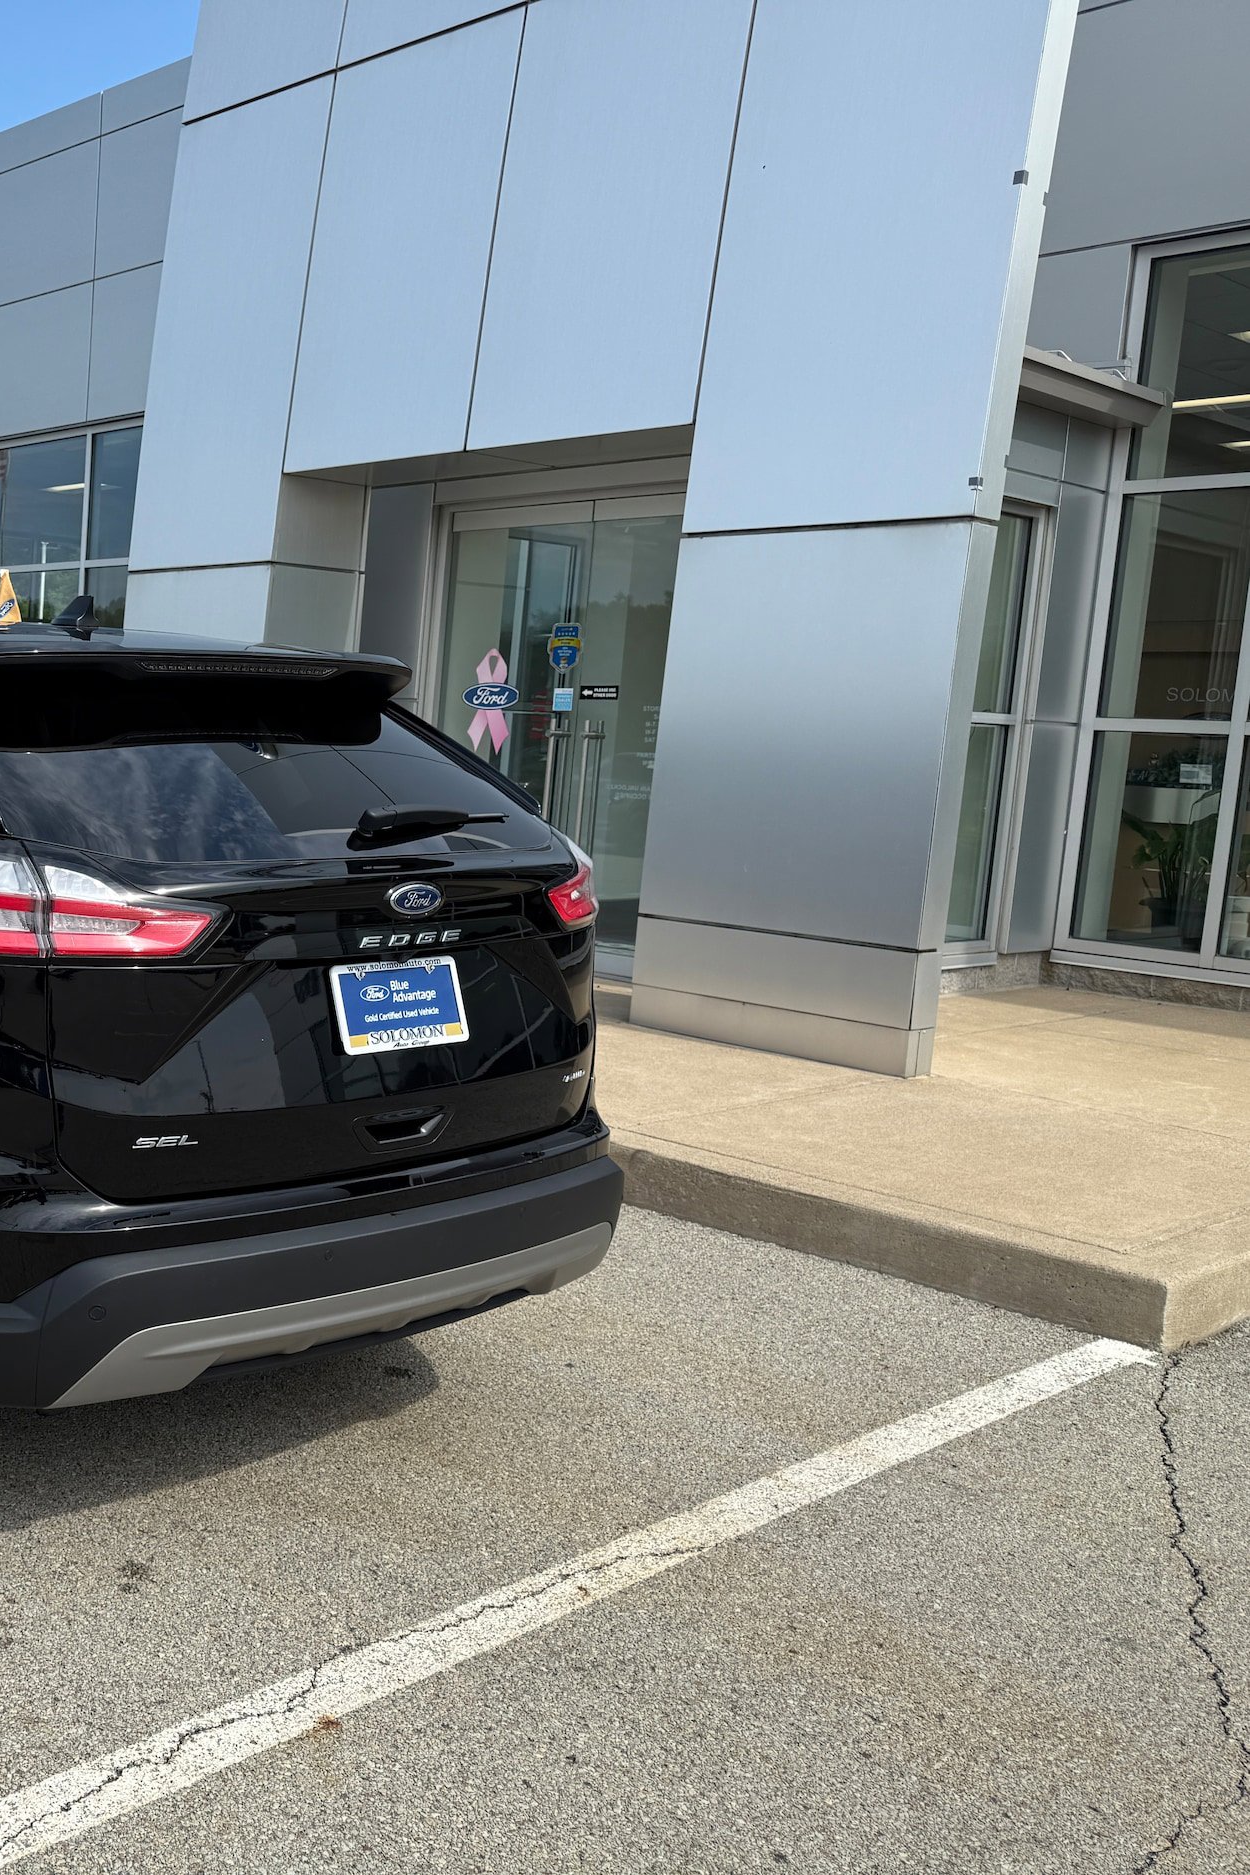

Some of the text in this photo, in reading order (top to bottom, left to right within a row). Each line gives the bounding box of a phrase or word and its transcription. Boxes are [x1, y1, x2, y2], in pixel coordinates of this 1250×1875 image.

[473, 687, 509, 705] Ford
[404, 890, 432, 908] Ford
[359, 929, 462, 949] EDGE
[366, 987, 385, 1000] Ford
[390, 980, 409, 991] Blue
[392, 989, 437, 1003] Advantage
[364, 1006, 440, 1023] Gold Certified Used Vehicle
[370, 1023, 446, 1045] SOLOMON
[132, 1134, 199, 1149] SEL
